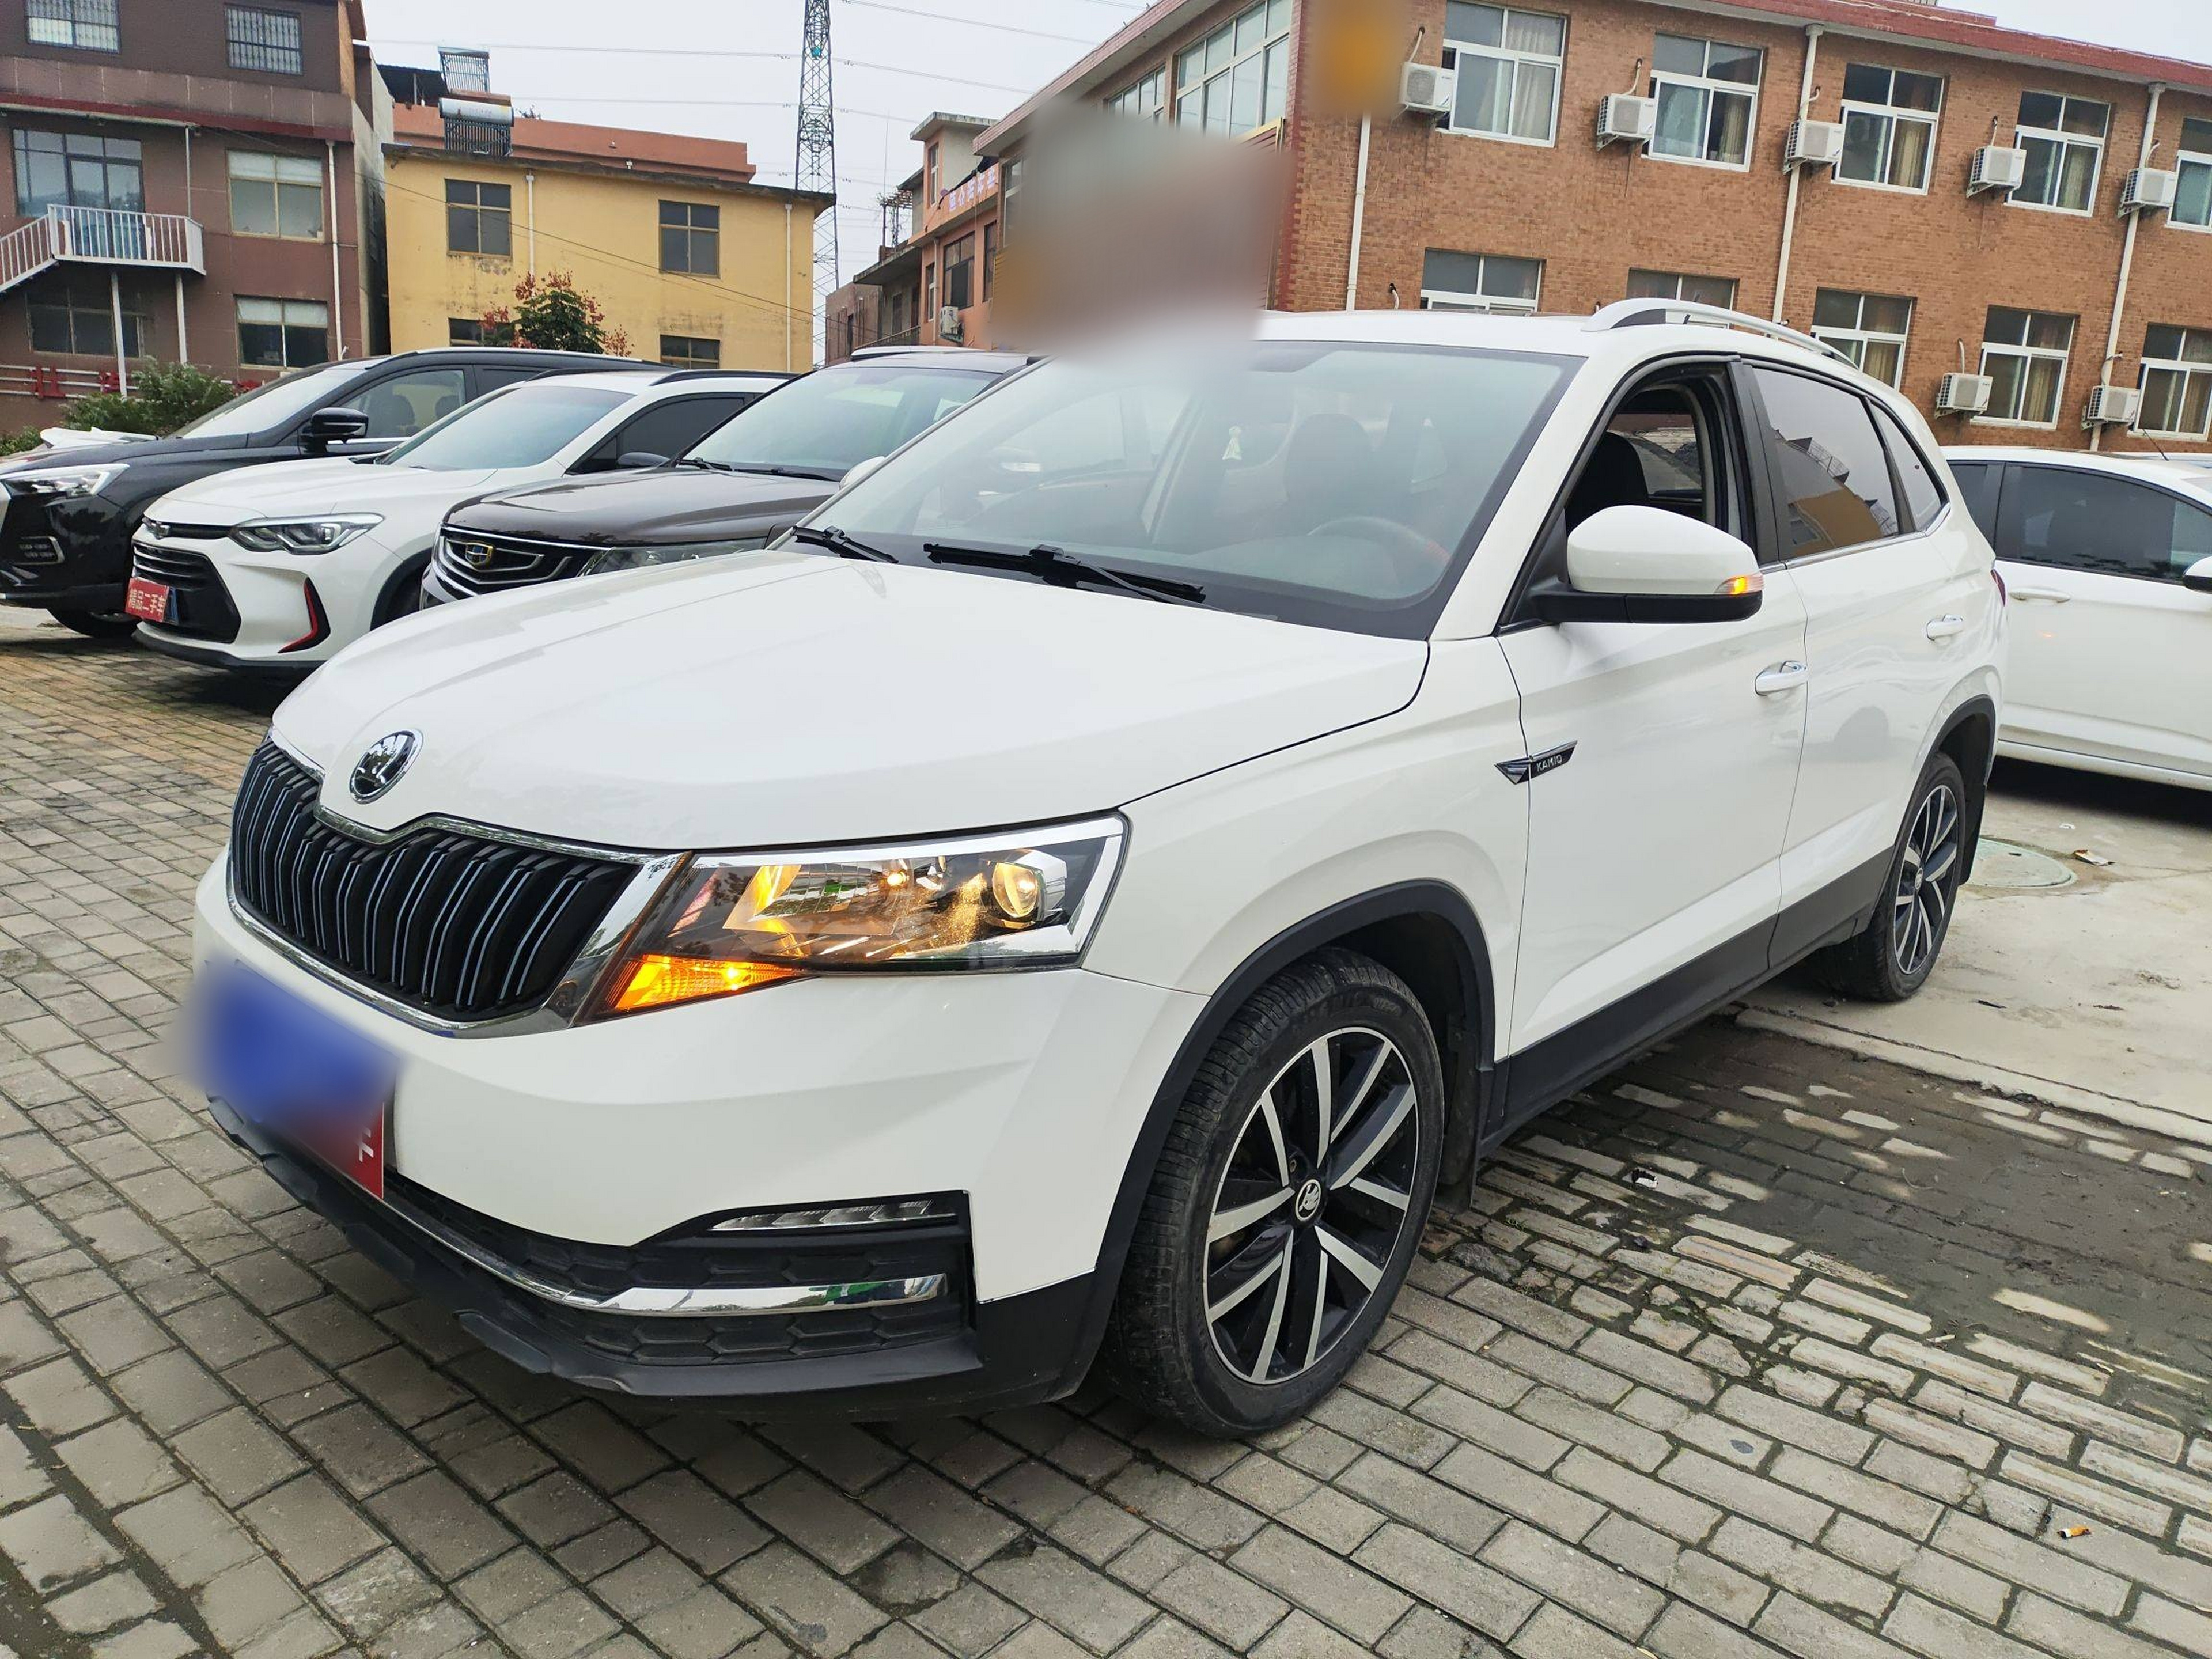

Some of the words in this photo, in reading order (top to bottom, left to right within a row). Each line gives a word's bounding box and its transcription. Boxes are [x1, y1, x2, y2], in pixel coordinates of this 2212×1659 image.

[128, 588, 165, 615] 精品二手车
